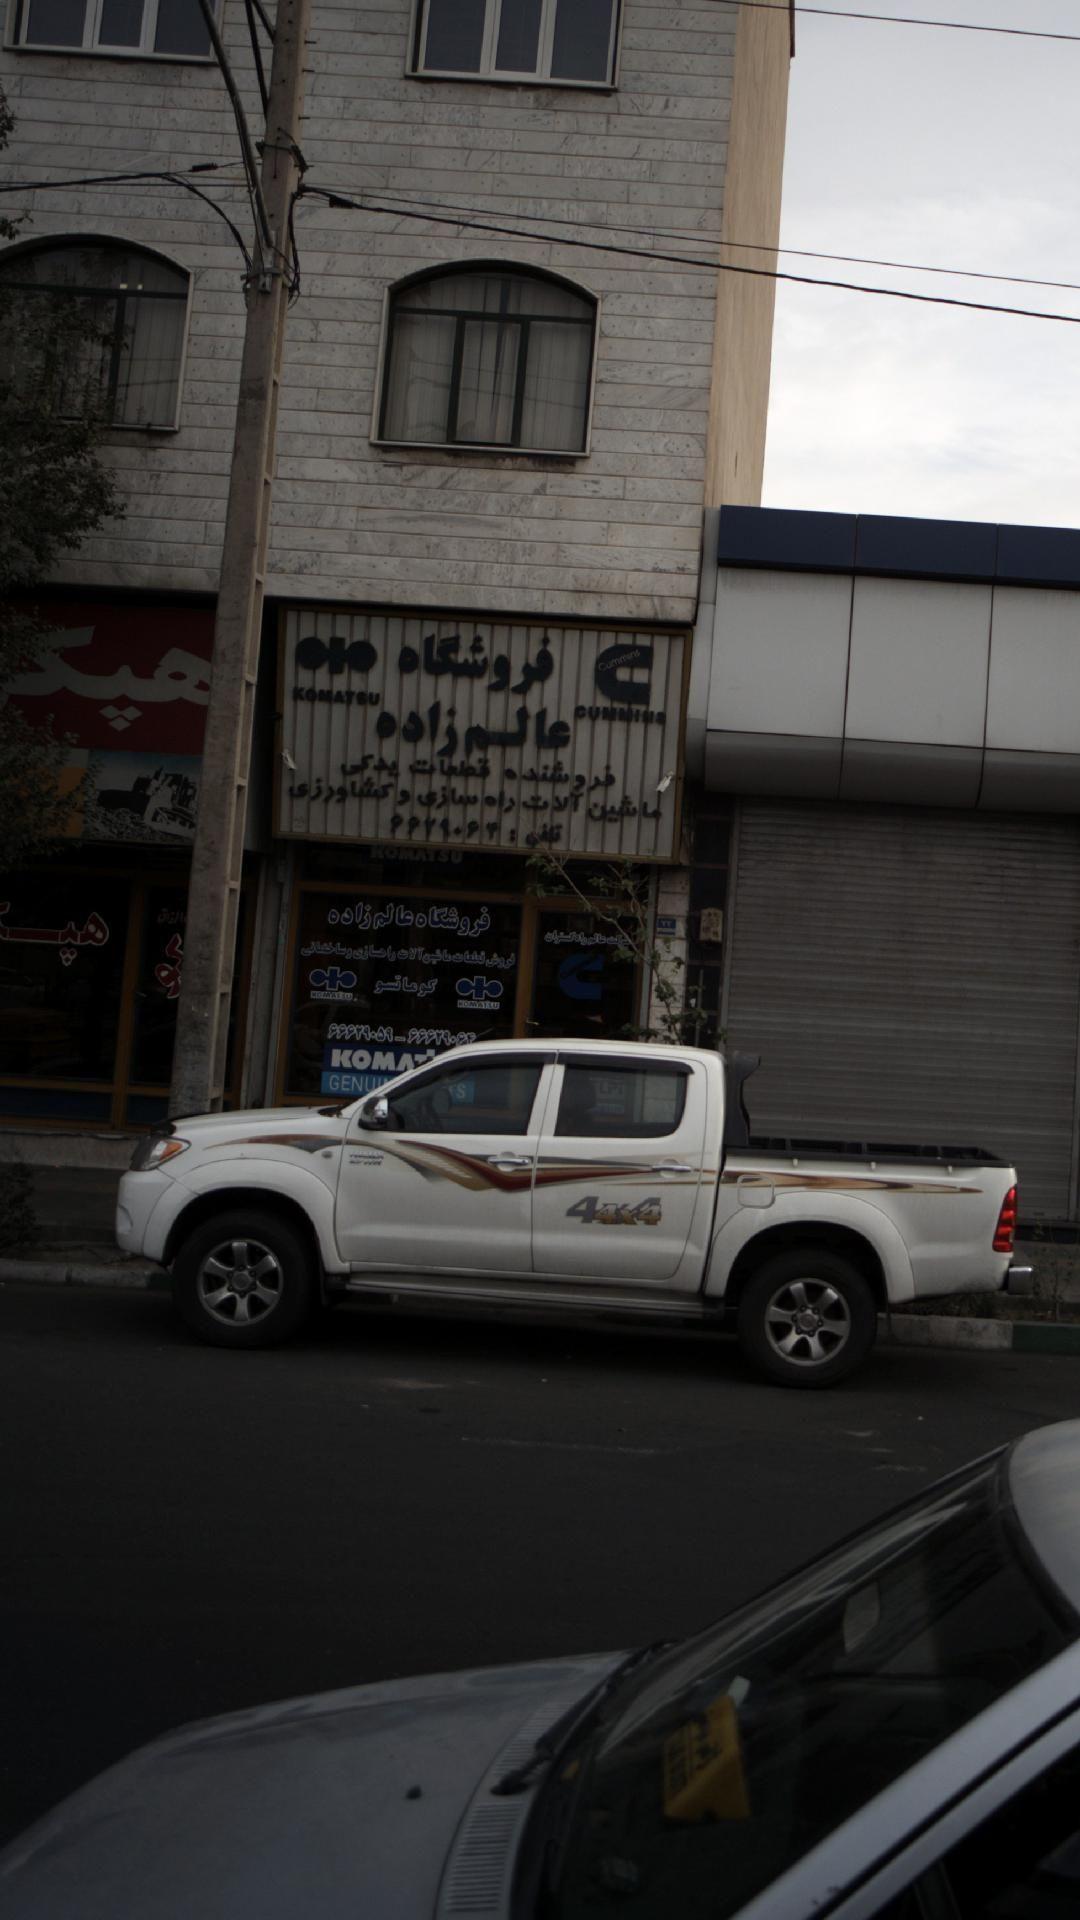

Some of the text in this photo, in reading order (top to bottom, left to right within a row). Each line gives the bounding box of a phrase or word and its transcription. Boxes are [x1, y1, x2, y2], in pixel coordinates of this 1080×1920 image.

[398, 633, 554, 693] فروشگاه
[292, 687, 381, 706] KOMATSU
[575, 706, 667, 725] CUMMINS
[341, 754, 616, 791] فروشنده قطعات یدکی
[289, 777, 394, 803] کشاورزی
[398, 789, 410, 806] و
[522, 791, 584, 813] آلات
[588, 795, 662, 822] ماشین
[369, 846, 464, 865] KOMATSU
[415, 905, 491, 937] فروشگاه
